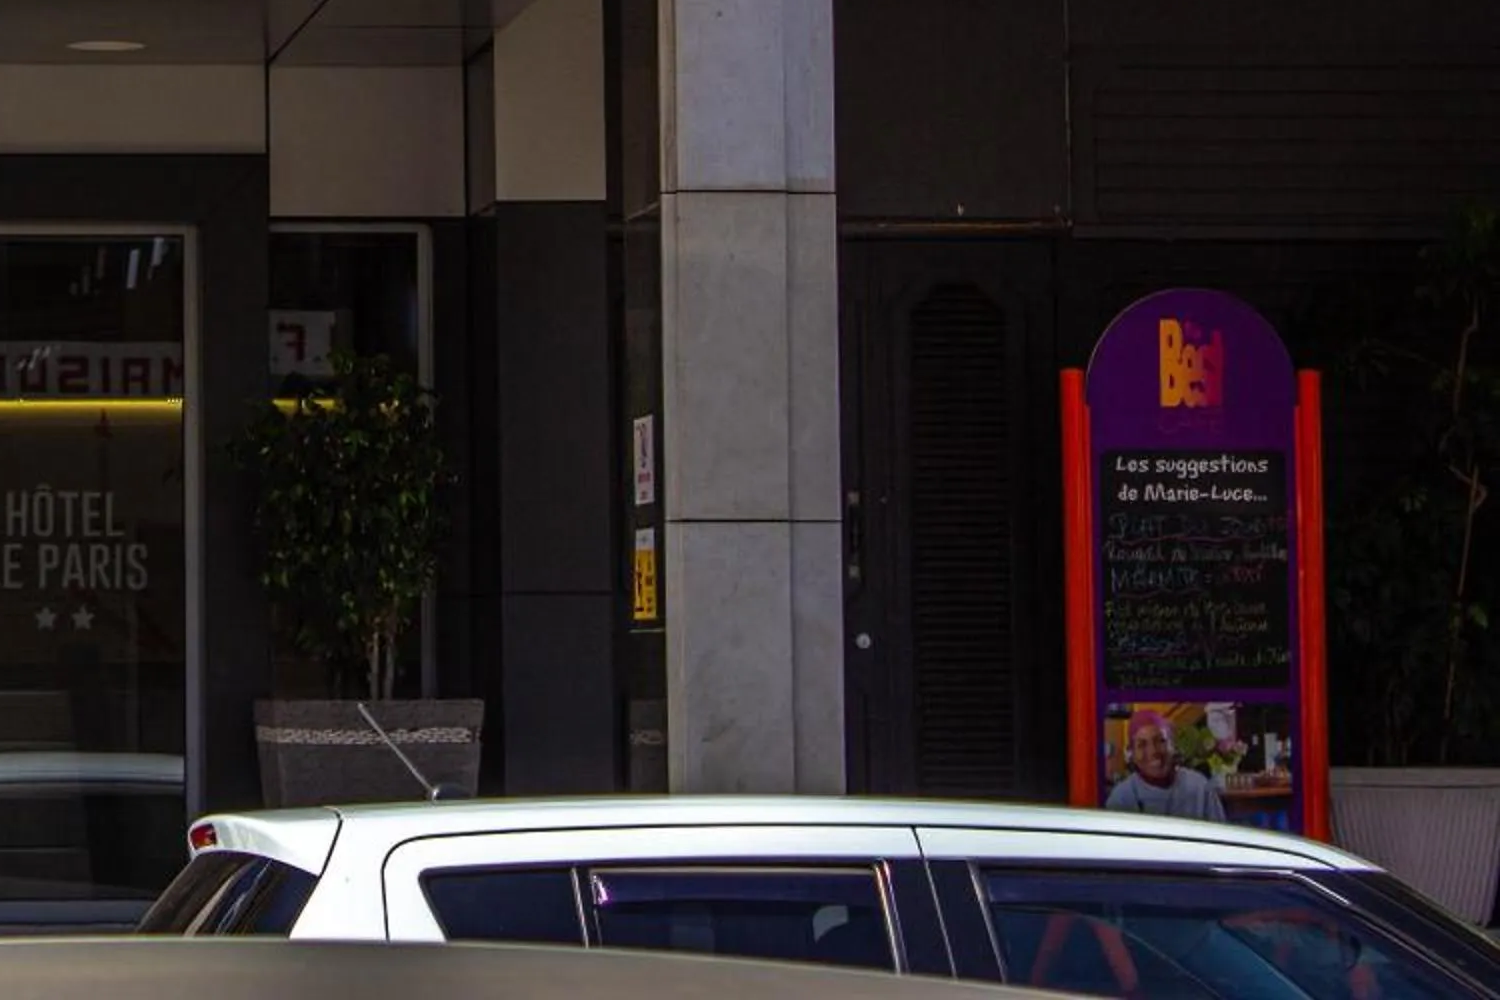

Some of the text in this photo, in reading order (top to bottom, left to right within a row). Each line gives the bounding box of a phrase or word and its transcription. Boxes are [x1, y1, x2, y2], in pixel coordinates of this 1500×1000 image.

[1115, 454, 1269, 479] Les suggestions
[5, 483, 125, 537] HÔTEL
[1117, 483, 1138, 501] de
[38, 543, 148, 590] PARIS
